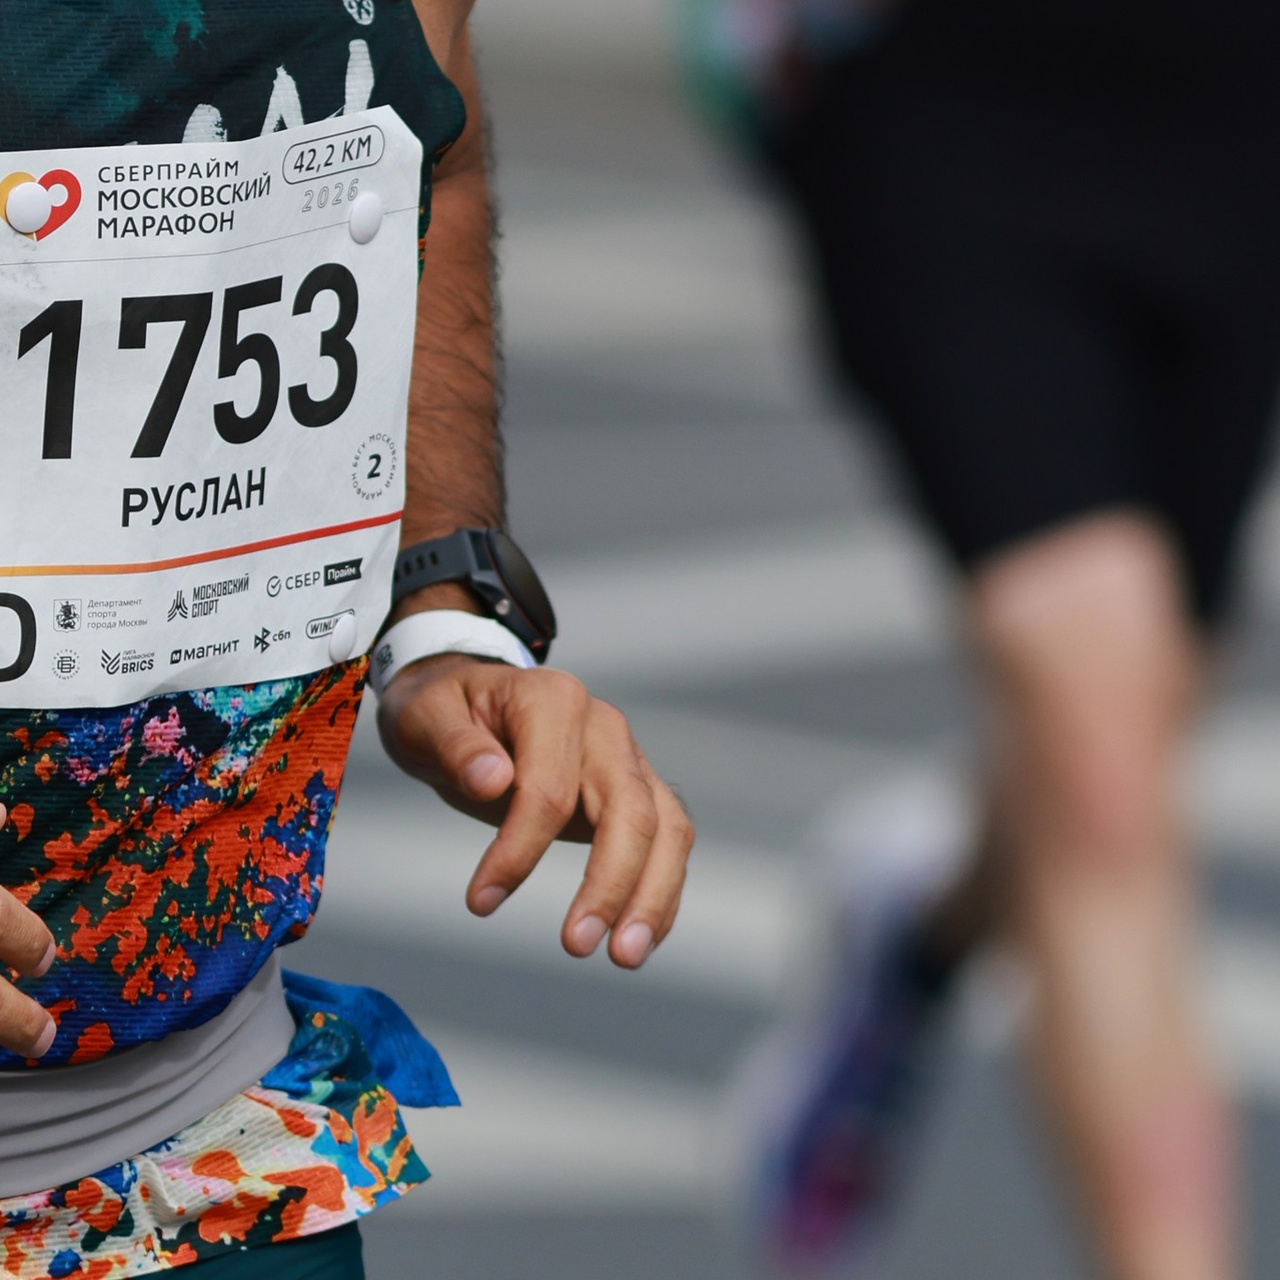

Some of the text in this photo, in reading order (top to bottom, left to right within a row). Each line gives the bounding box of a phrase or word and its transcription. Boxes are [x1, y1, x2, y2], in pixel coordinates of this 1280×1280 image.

[293, 134, 371, 173] 42,2 КМ
[98, 158, 239, 183] СБЕРПРАЙМ
[98, 171, 271, 211] МОСКОВСКИЙ
[301, 178, 359, 212] 2026
[98, 210, 234, 239] МАРАФОН
[17, 262, 360, 459] 1753
[367, 453, 381, 479] 2
[122, 467, 266, 527] РУСЛАН
[193, 573, 249, 601] МОСКОВСКИЙ
[285, 565, 355, 590] СБЕР Прайм
[87, 599, 142, 608] Департамент
[87, 611, 116, 619] спорта
[192, 599, 219, 618] СПОРТ
[87, 619, 147, 630] города Москвы
[272, 630, 291, 641] сбп
[121, 659, 154, 674] BRICS
